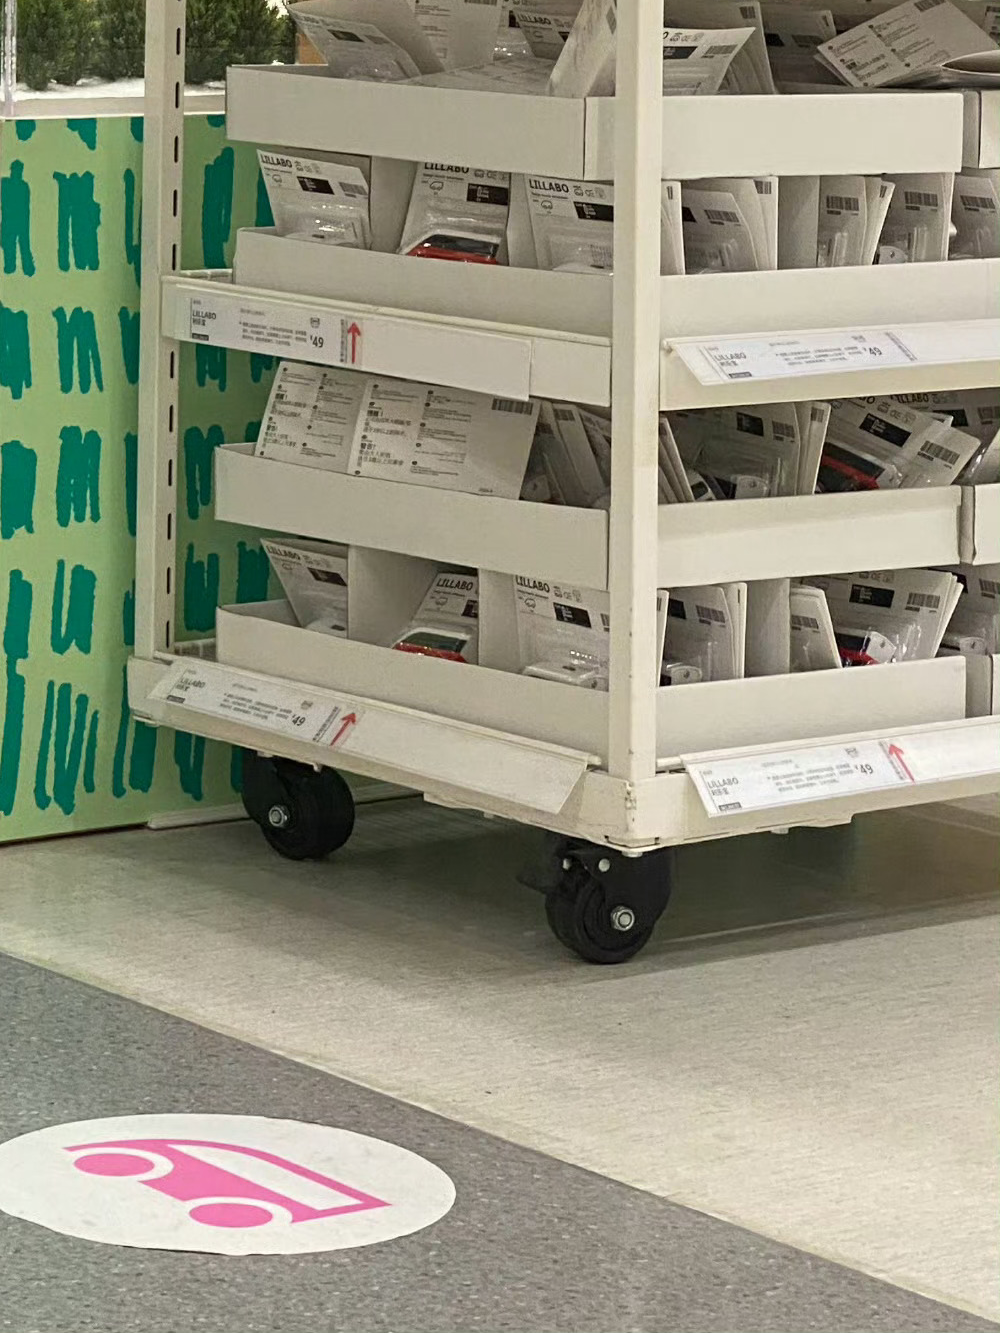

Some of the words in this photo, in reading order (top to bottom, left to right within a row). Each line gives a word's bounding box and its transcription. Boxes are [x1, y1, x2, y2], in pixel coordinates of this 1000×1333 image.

[260, 153, 293, 168] LILLABO
[529, 178, 570, 194] LILLABO
[265, 544, 301, 562] LILLABO
[436, 577, 474, 591] LILLABO
[515, 575, 551, 594] LILLABO
